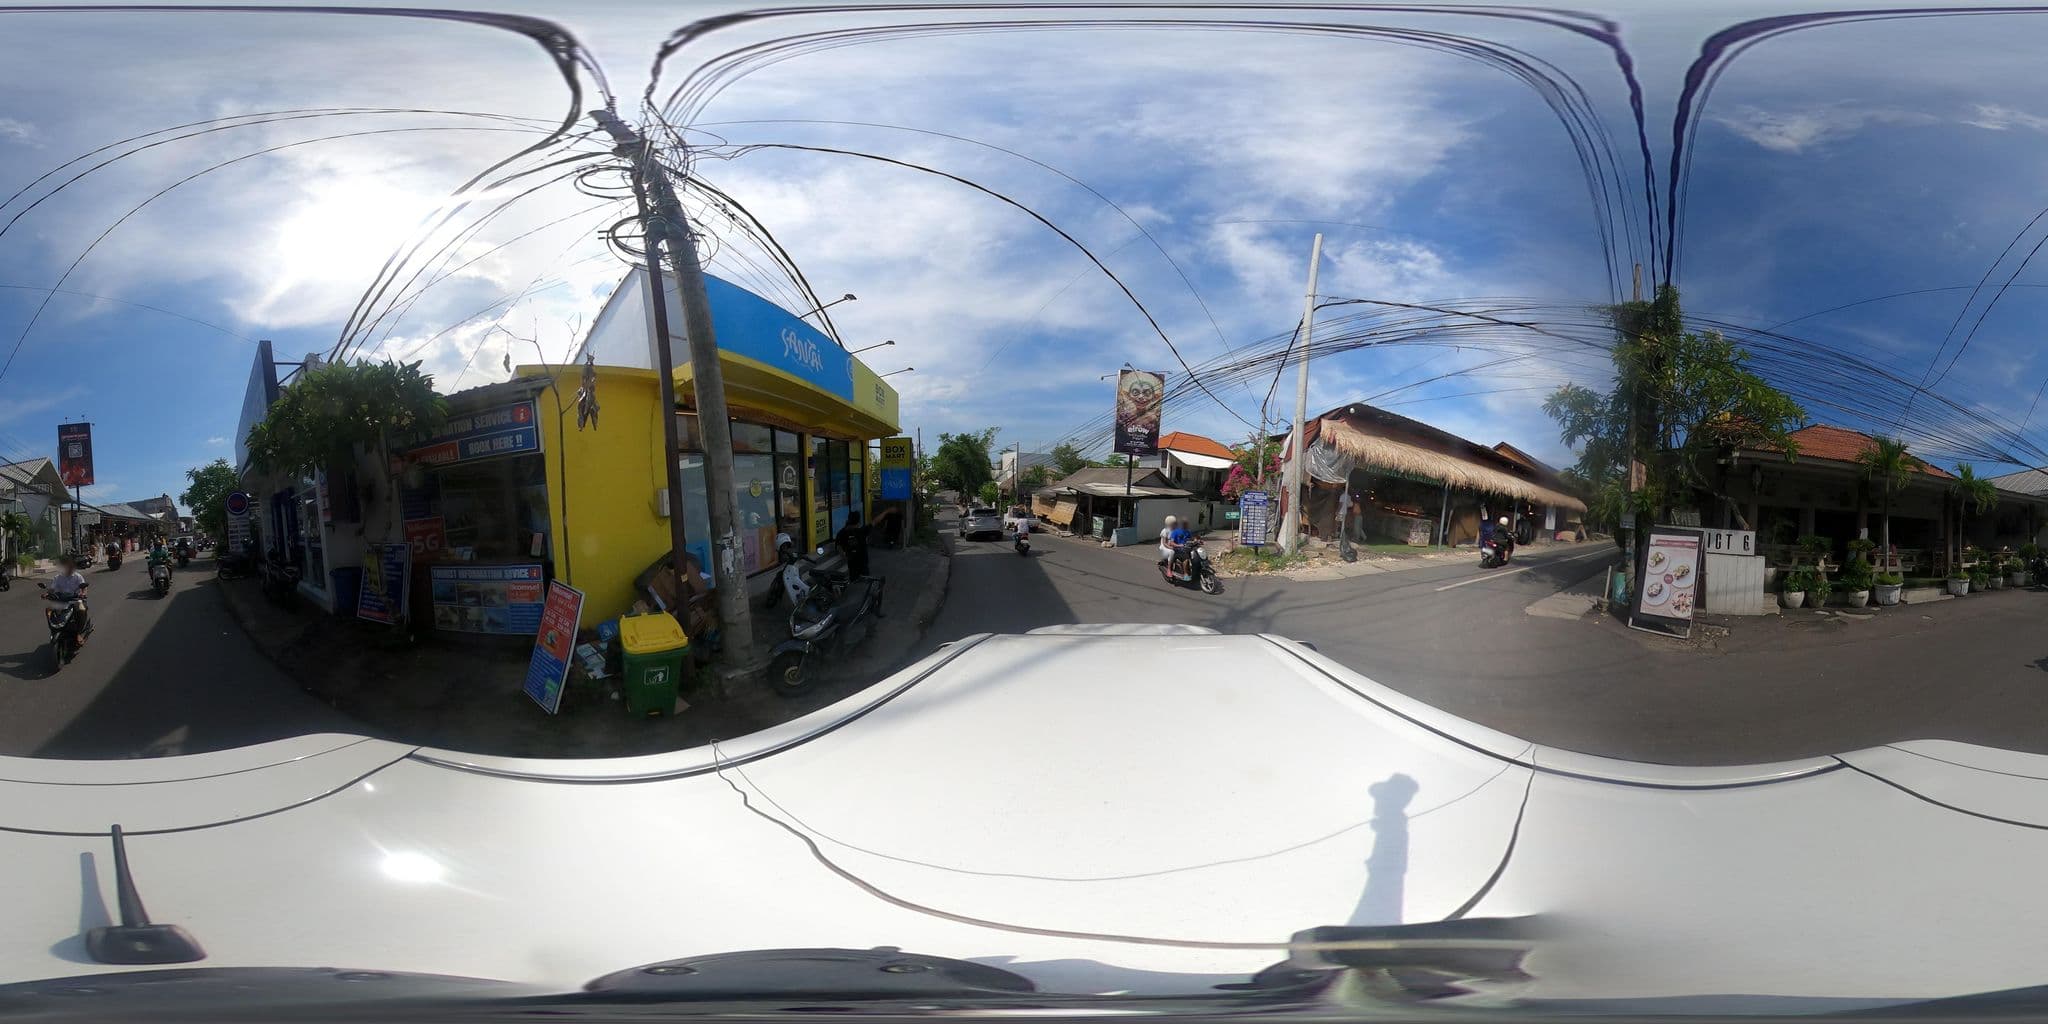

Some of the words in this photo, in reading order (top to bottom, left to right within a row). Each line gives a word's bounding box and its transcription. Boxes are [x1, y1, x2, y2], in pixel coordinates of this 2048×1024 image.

[474, 410, 512, 431] SERVICE
[469, 440, 491, 455] BOOK
[493, 436, 514, 450] HERE
[885, 446, 905, 454] BOX
[414, 533, 440, 555] 5G
[1743, 534, 1750, 552] 6
